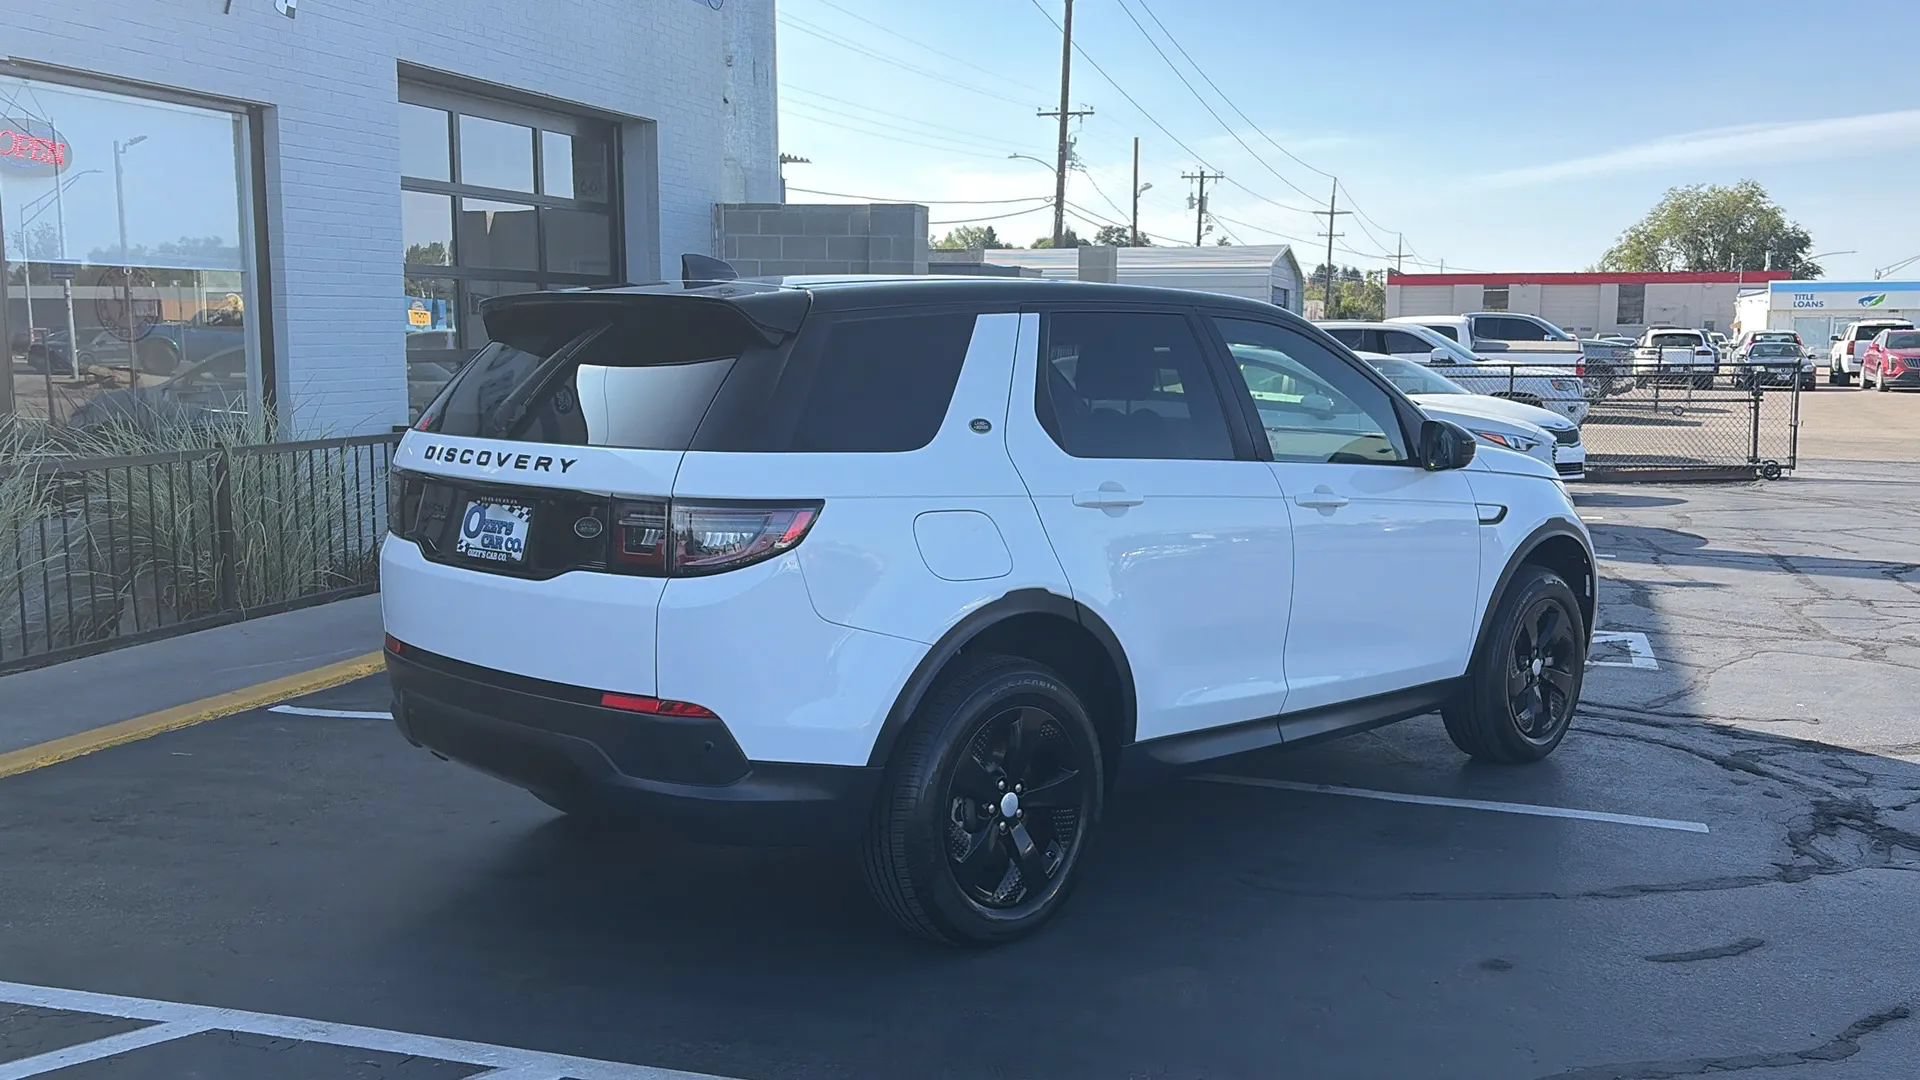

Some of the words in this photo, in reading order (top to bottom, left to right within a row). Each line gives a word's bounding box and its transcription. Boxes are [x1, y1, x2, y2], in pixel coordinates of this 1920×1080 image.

[0, 130, 65, 167] OPEN
[1793, 300, 1824, 308] LOANS
[1794, 293, 1815, 301] TITLE
[424, 445, 578, 474] DISCOVERY
[481, 533, 504, 551] CAR
[486, 550, 498, 560] CAR
